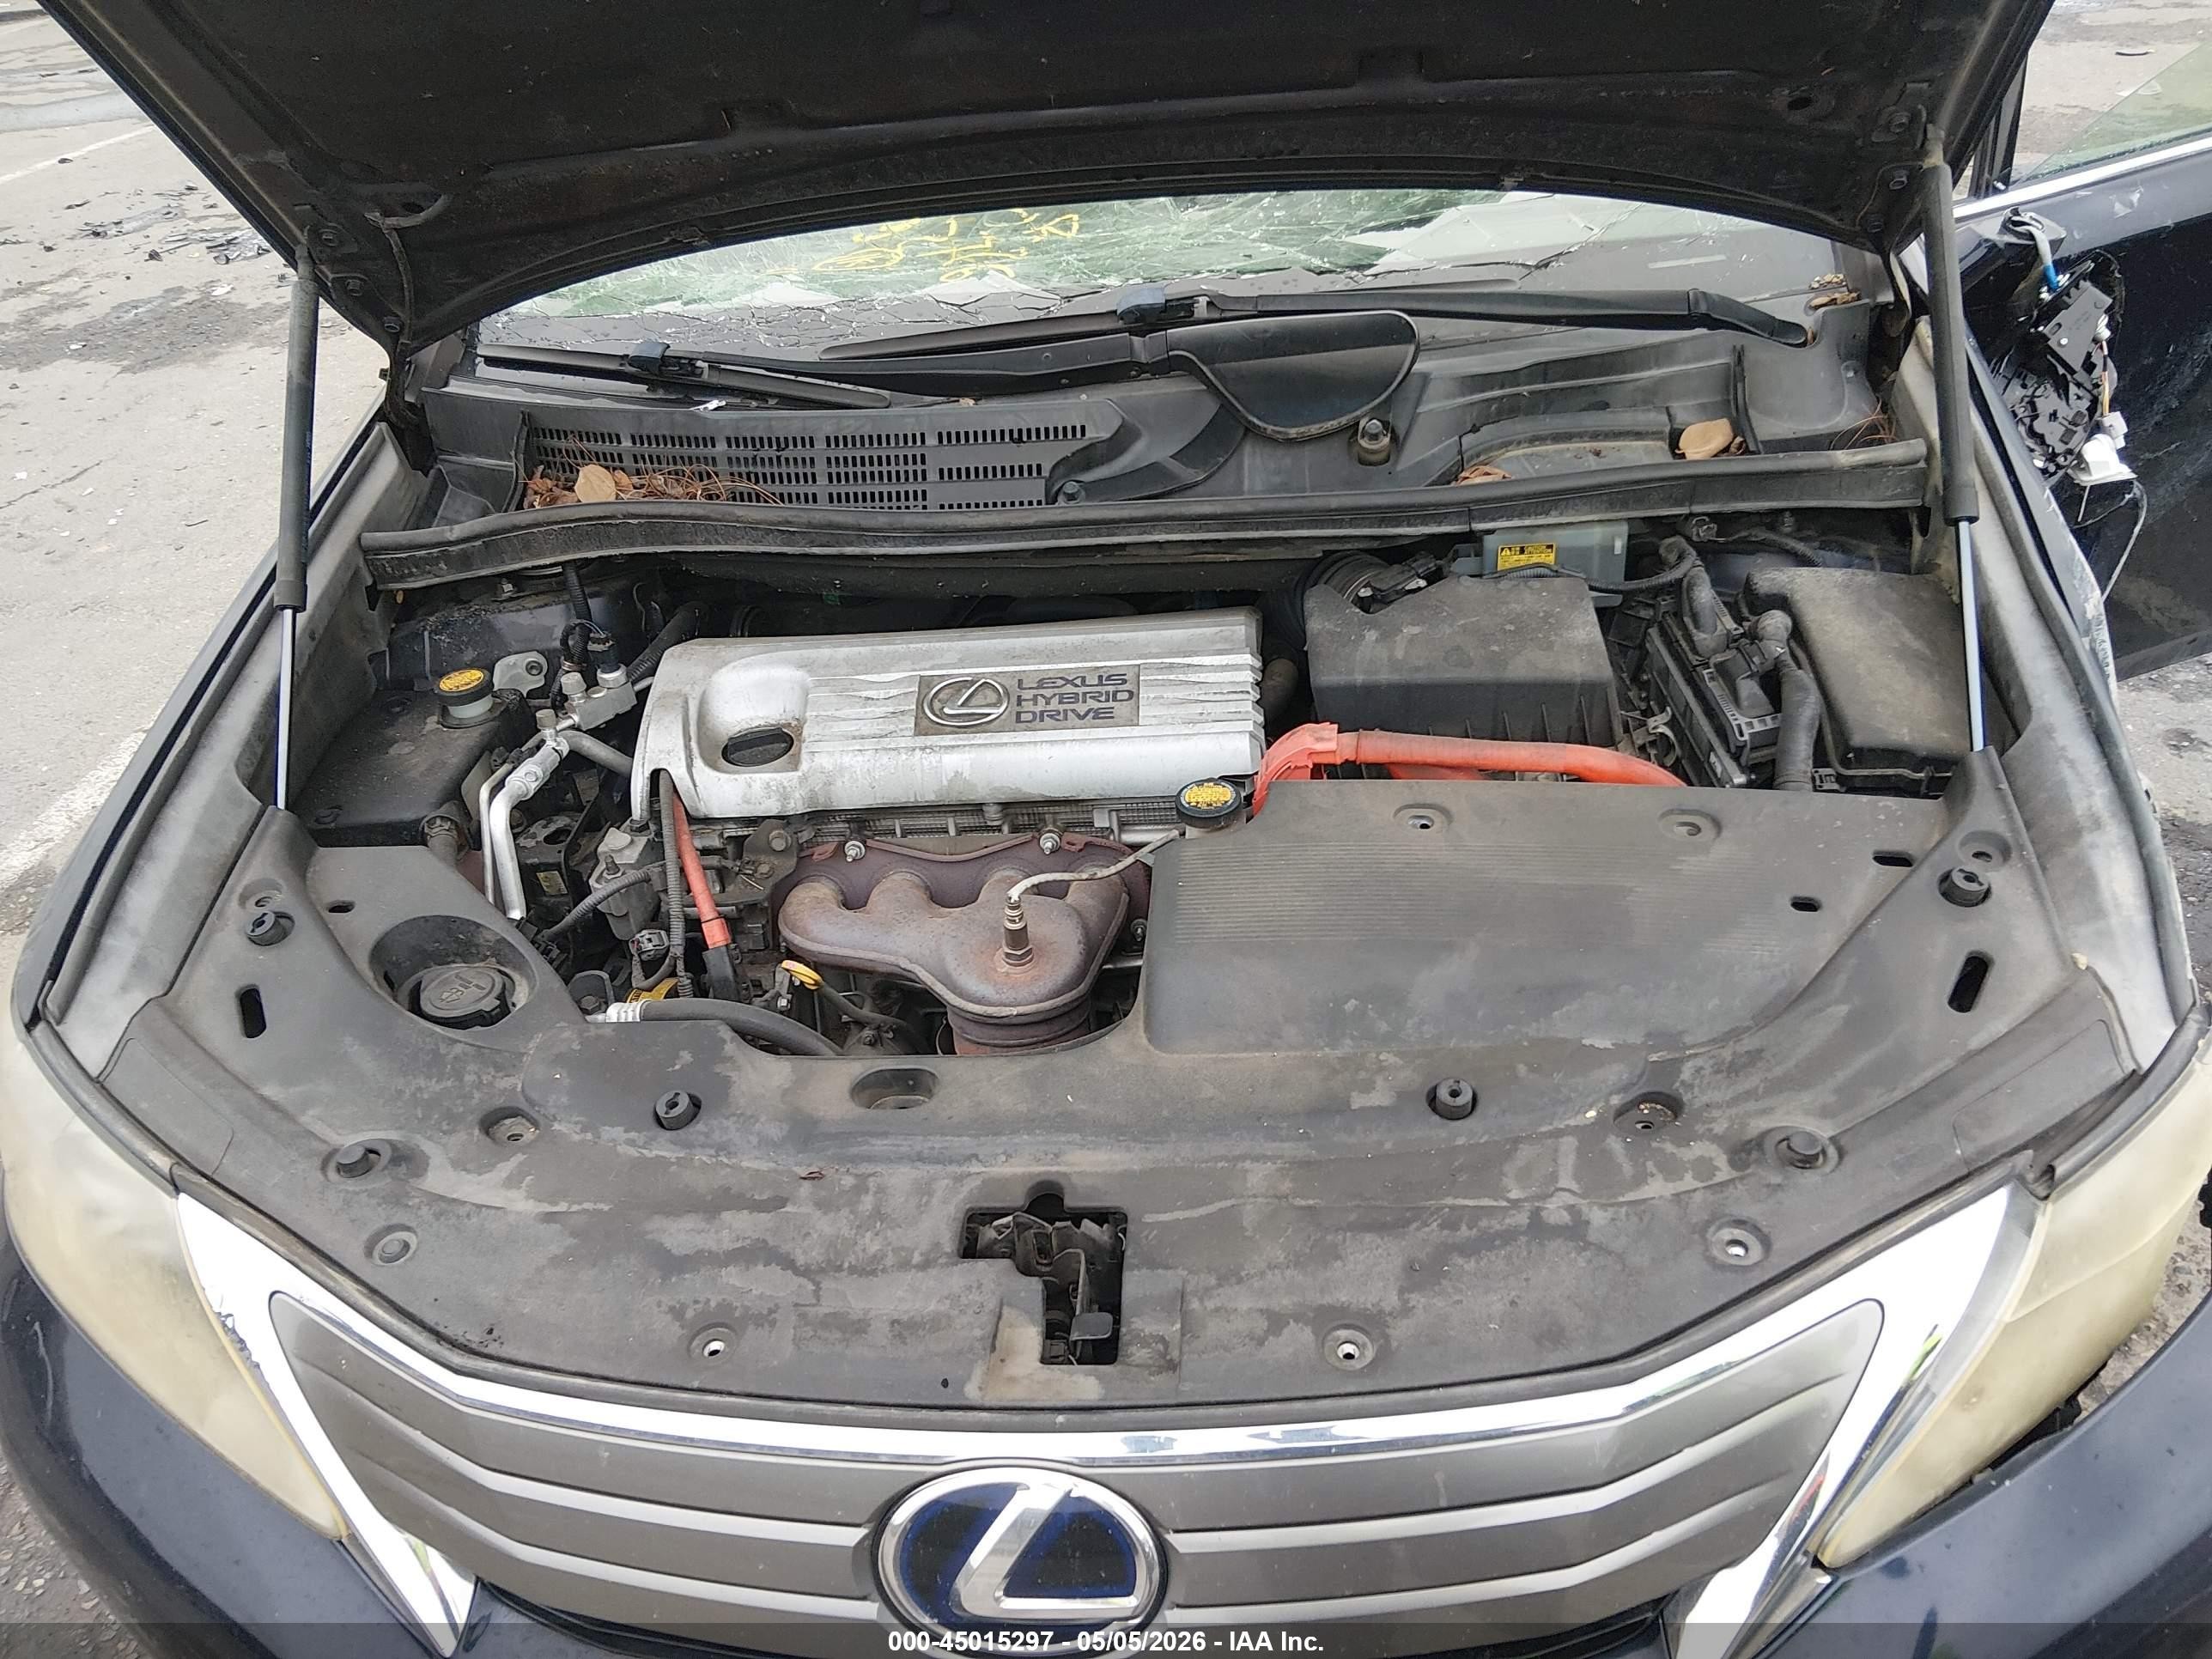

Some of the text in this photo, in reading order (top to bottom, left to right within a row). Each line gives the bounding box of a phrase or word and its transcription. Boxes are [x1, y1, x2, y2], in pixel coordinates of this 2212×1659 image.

[1018, 673, 1127, 690] LEXUS
[1017, 690, 1134, 707] HYBRID
[1015, 707, 1115, 724] DRIVE
